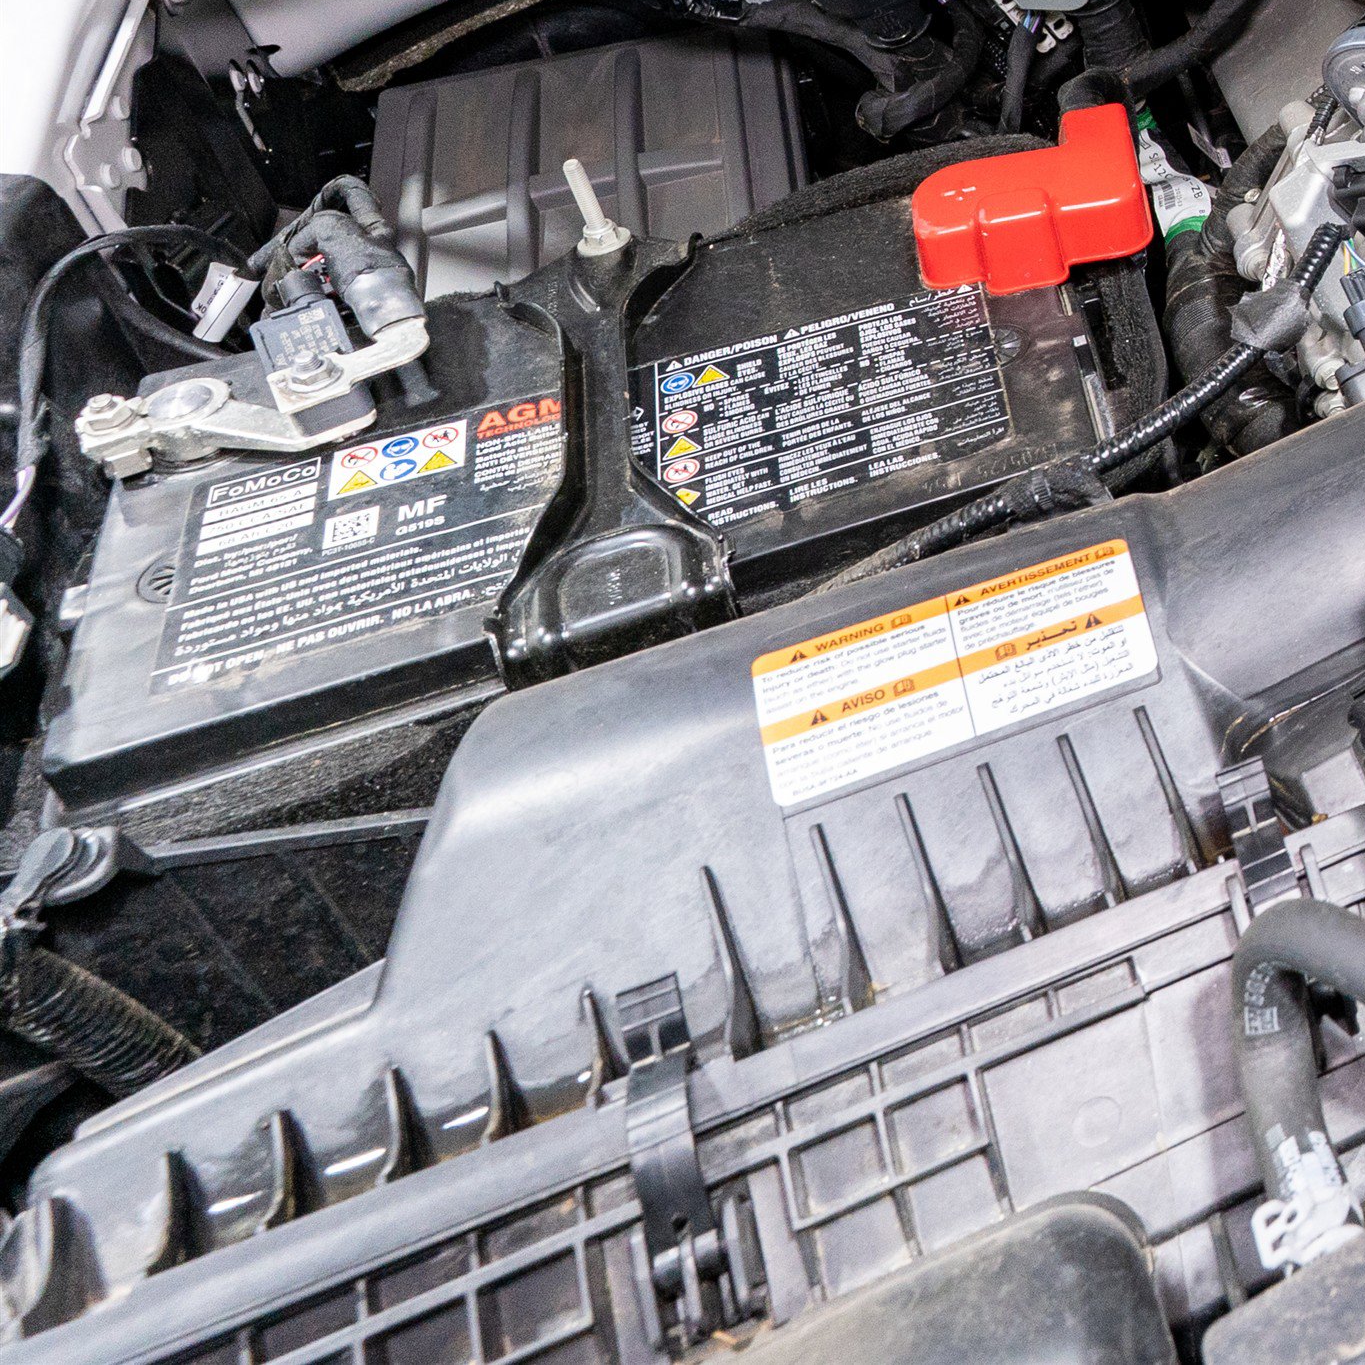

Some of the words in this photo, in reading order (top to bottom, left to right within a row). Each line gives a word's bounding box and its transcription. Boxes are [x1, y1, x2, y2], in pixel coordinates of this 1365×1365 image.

[684, 333, 777, 366] DANGER/POISON
[800, 302, 895, 335] PELIGRO/VENENO
[858, 318, 889, 331] PROTEJA
[889, 314, 902, 323] LOS
[860, 327, 901, 343] EXPLOSIVOS
[736, 358, 762, 370] SHIELD
[878, 349, 905, 361] CHISPAS
[879, 355, 905, 367] FLAMAS
[810, 364, 848, 380] ÉTINCELLES
[857, 378, 880, 391] ÁCIDO
[880, 366, 921, 385] SULFÚRICO
[664, 387, 704, 404] EXPLOSIVE
[705, 380, 728, 393] GASES
[730, 376, 743, 386] CAN
[744, 370, 765, 382] CAUSE
[664, 394, 701, 410] BLINDNESS
[712, 384, 738, 397] INJURY.
[723, 392, 749, 405] SPARKS
[764, 380, 789, 395] ÉVITEZ
[724, 398, 750, 411] FLAMES
[774, 401, 802, 416] L'ACIDE
[803, 388, 849, 407] SULFURIQUE
[889, 400, 902, 408] DEL
[703, 420, 738, 436] SULFURIC
[739, 414, 756, 426] ACID
[703, 430, 725, 442] CAUSE
[726, 420, 762, 436] BLINDNESS
[704, 452, 721, 462] KEEP
[723, 447, 736, 457] OUT
[738, 444, 747, 452] OF
[748, 441, 760, 449] THE
[705, 457, 728, 470] REACH
[739, 443, 775, 460] CHILDREN.
[868, 460, 884, 471] LEA
[886, 454, 904, 465] LAS
[869, 449, 941, 479] INSTRUCCIONES.
[211, 462, 317, 502] FoMoCo
[705, 472, 726, 484] FLUSH
[705, 472, 750, 492] IMMEDIATELY
[751, 467, 768, 478] WITH
[732, 480, 745, 490] GET
[789, 483, 809, 496] LIRE
[810, 477, 828, 489] LES
[790, 475, 857, 503] INSTRUCTIONS.
[706, 490, 735, 505] MEDICAL
[736, 484, 754, 496] HELP
[755, 479, 773, 490] FAST.
[396, 493, 448, 523] MF
[708, 506, 733, 521] READ
[182, 604, 215, 620] Made
[215, 600, 228, 610] in
[229, 592, 254, 606] USA
[254, 585, 279, 599] with
[298, 573, 319, 586] and
[320, 559, 368, 580] imported
[369, 544, 423, 566] materials.
[274, 602, 294, 615] EE.
[295, 595, 317, 609] UU.
[340, 573, 397, 595] materiales
[397, 549, 485, 579] estadounidenses
[979, 552, 1091, 596] AVERTISSEMENT
[253, 587, 310, 611] États-Unis
[957, 604, 979, 616] Pour
[982, 592, 1014, 607] réduire
[1028, 578, 1056, 593] risque
[1071, 558, 1115, 577] blessures
[275, 638, 295, 654] NE
[296, 629, 325, 648] PAS
[326, 613, 385, 639] OUVRIR.
[390, 605, 412, 620] NO
[413, 598, 434, 614] LA
[434, 587, 476, 608] ABRA.
[958, 609, 990, 625] graves
[814, 622, 884, 652] WARNING
[846, 636, 887, 656] possible
[889, 624, 925, 640] serious
[892, 635, 920, 649] starter
[922, 626, 946, 639] fluids
[919, 636, 947, 650] starter
[1023, 619, 1078, 651] تحذير
[840, 688, 885, 712] AVISO
[849, 711, 880, 728] riesgo
[898, 690, 939, 710] lesiones
